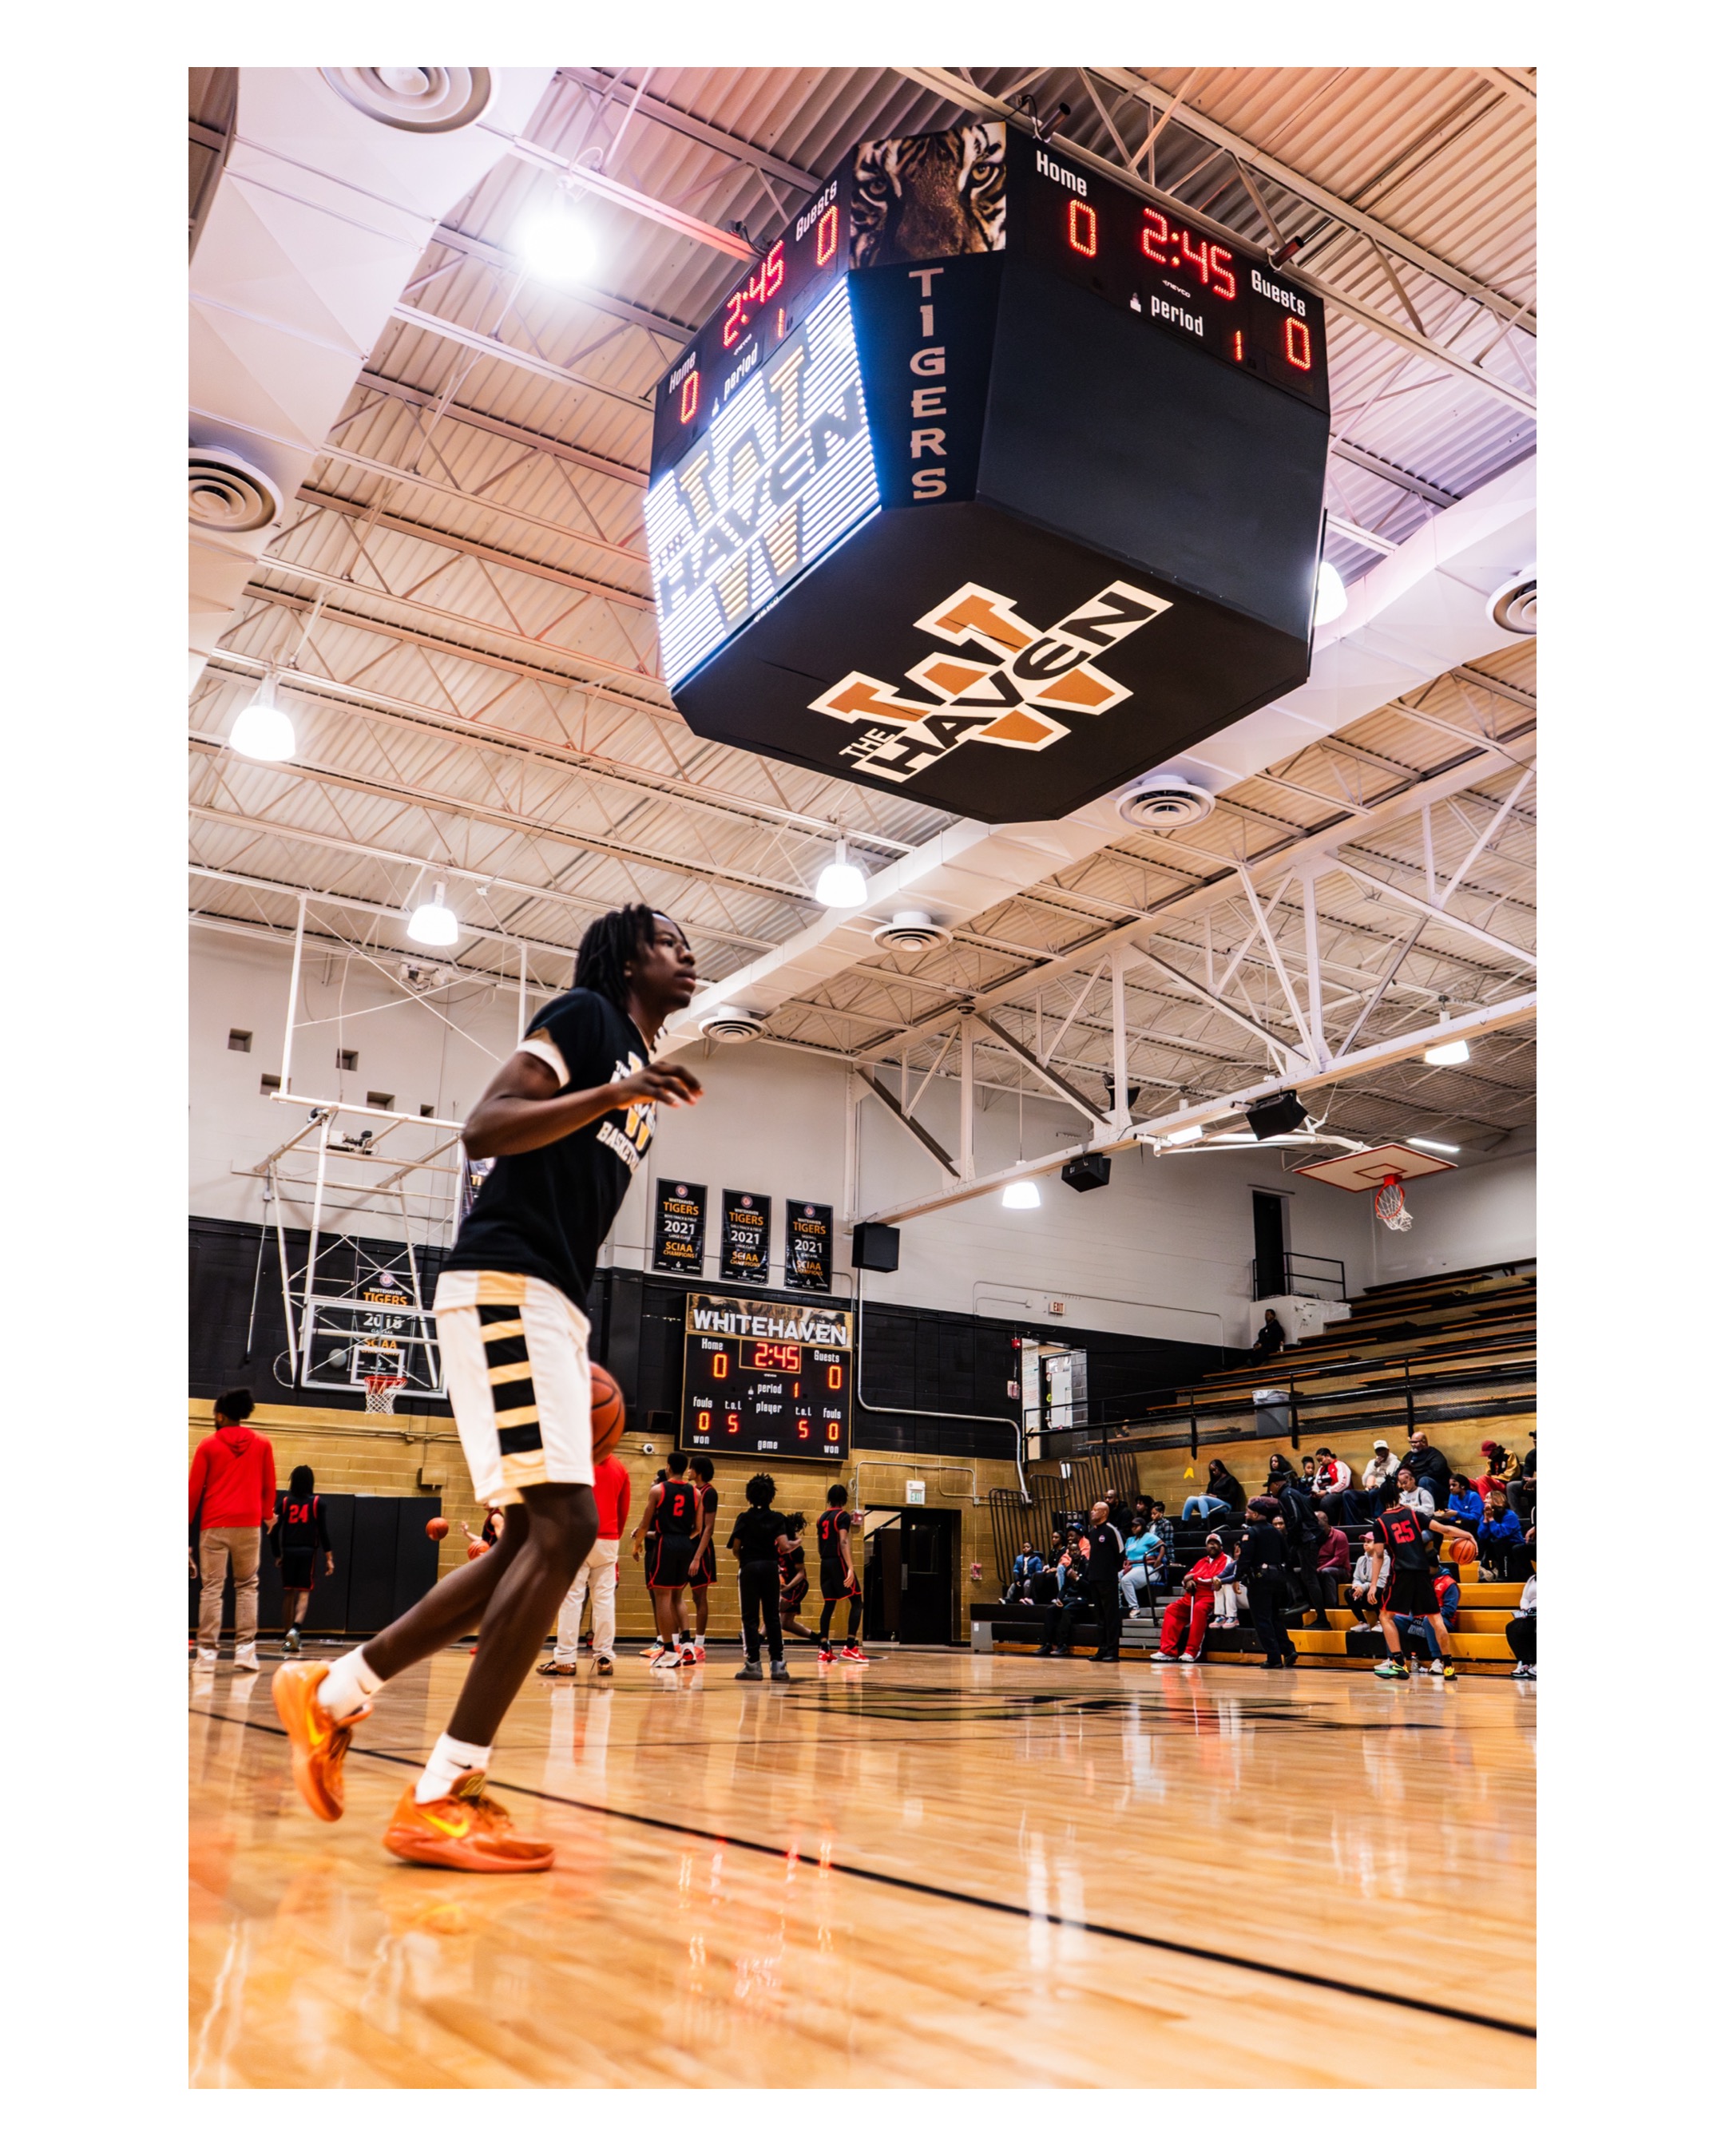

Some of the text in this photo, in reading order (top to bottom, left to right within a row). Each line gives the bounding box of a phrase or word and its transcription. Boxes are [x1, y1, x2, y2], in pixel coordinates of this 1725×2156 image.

[1036, 150, 1087, 197] Home
[795, 180, 838, 242] Guests
[816, 204, 839, 267] 0
[1069, 199, 1096, 257] 0
[1142, 208, 1236, 301] 2:45
[723, 239, 786, 348] 2:45
[1251, 268, 1307, 317] Guests
[1151, 295, 1204, 337] period
[1235, 330, 1243, 361] 1
[1285, 316, 1312, 371] 0
[668, 351, 697, 394] Home
[724, 342, 759, 402] period
[909, 268, 947, 499] TIGERS
[680, 370, 700, 424] 0
[864, 590, 1158, 776] HAVEN
[839, 727, 897, 758] THE
[663, 1201, 699, 1215] TIGERS
[664, 1220, 695, 1235] 2021
[729, 1211, 763, 1226] TIGERS
[793, 1221, 827, 1235] TIGERS
[731, 1230, 759, 1245] 2021
[795, 1239, 823, 1254] 2021
[663, 1249, 695, 1259] CHAMPIONS
[665, 1242, 692, 1253] SCIAA
[732, 1250, 759, 1262] SCIAA
[796, 1259, 822, 1270] SCIAA
[363, 1292, 408, 1306] TIGERS
[1053, 1302, 1064, 1312] EXIT
[363, 1313, 402, 1330] 2018
[693, 1309, 847, 1346] WHITEHAVEN
[701, 1338, 724, 1351] Home
[713, 1353, 728, 1378] 0
[755, 1342, 799, 1370] 2:45
[814, 1349, 840, 1363] Guests
[828, 1365, 842, 1389] 0
[757, 1383, 783, 1395] period
[794, 1381, 799, 1398] 1
[693, 1396, 713, 1409] fouls
[755, 1401, 783, 1414] player
[698, 1412, 710, 1431] 0
[728, 1413, 739, 1433] 5
[823, 1407, 842, 1420] fouls
[798, 1420, 809, 1438] 5
[828, 1422, 839, 1441] 0
[693, 1435, 710, 1445] won
[757, 1440, 778, 1451] game
[823, 1445, 839, 1455] won
[673, 1494, 685, 1516] 2
[910, 1491, 922, 1502] EXIT
[288, 1504, 309, 1524] 24
[822, 1520, 829, 1540] 3
[1390, 1520, 1416, 1544] 25
